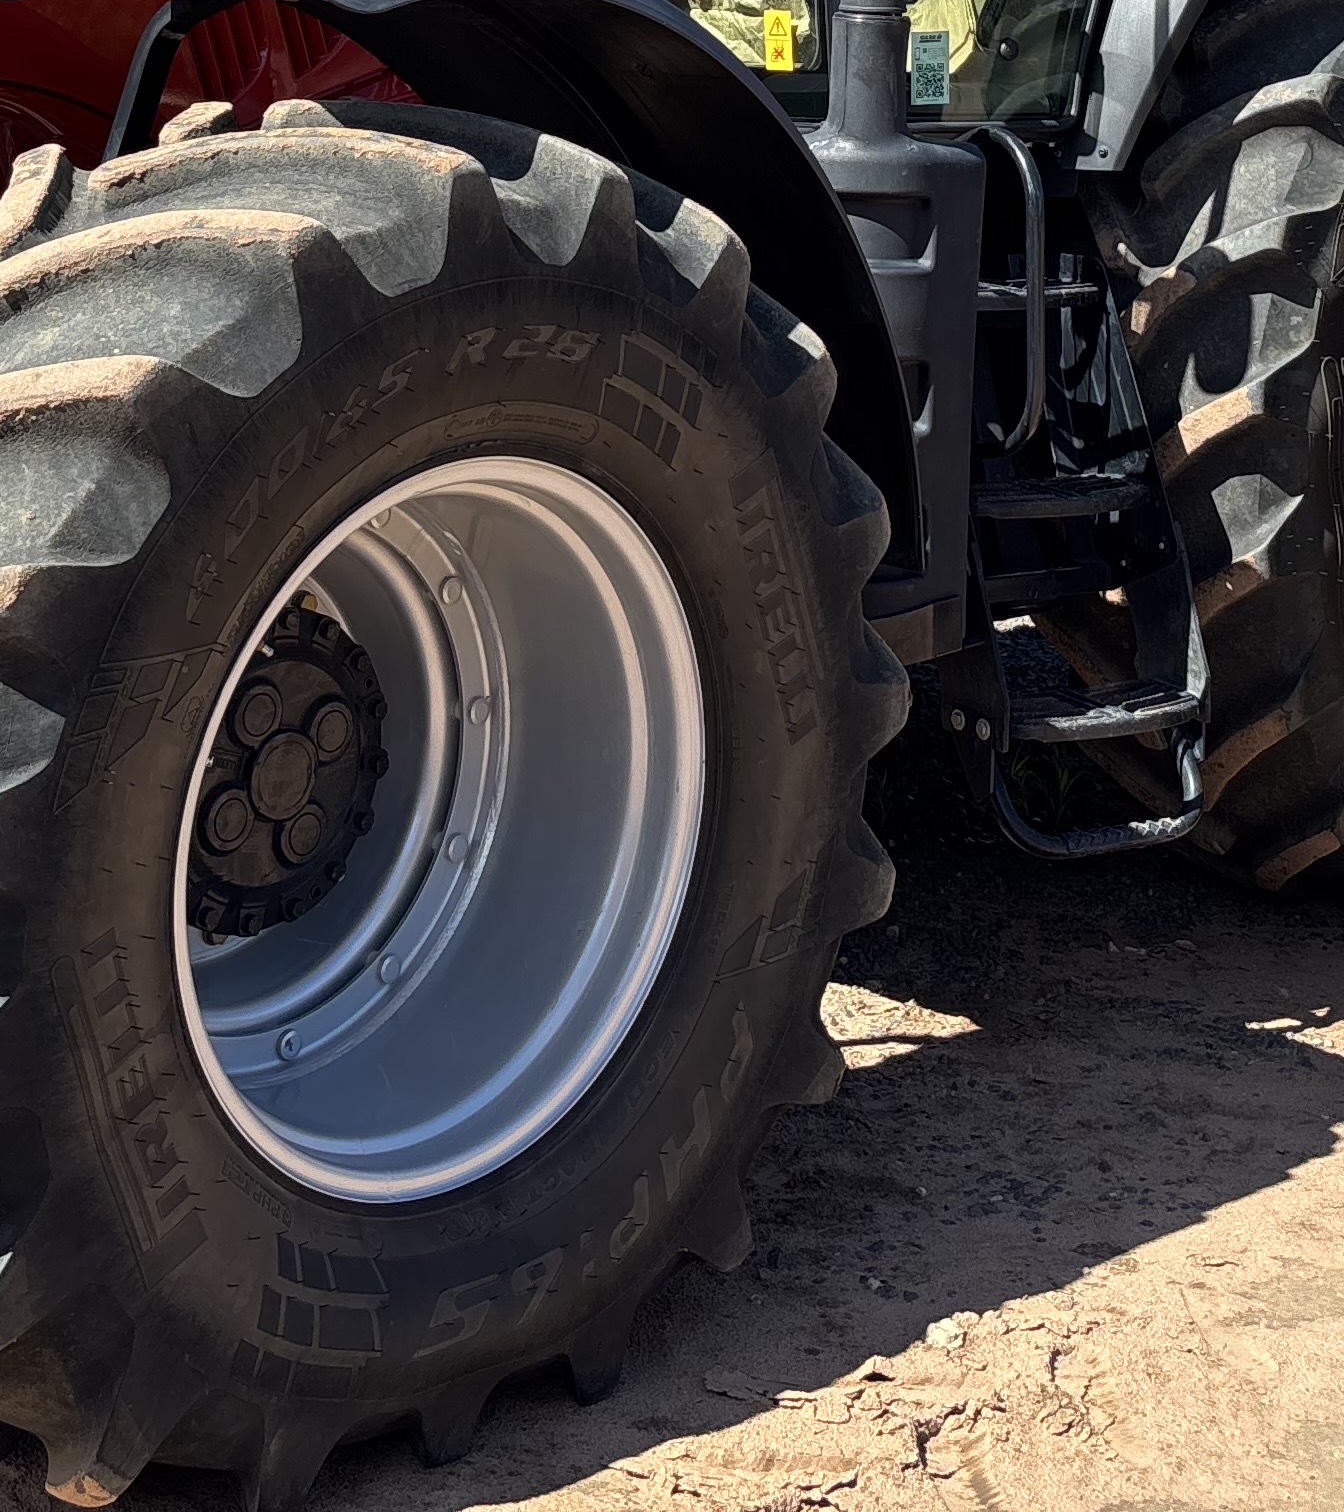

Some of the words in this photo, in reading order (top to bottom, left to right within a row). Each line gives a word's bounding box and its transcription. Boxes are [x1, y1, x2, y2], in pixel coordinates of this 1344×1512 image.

[445, 325, 502, 376] R
[501, 323, 605, 365] 28
[728, 446, 828, 746] PIRELLI
[49, 926, 208, 1291] PIRELLI
